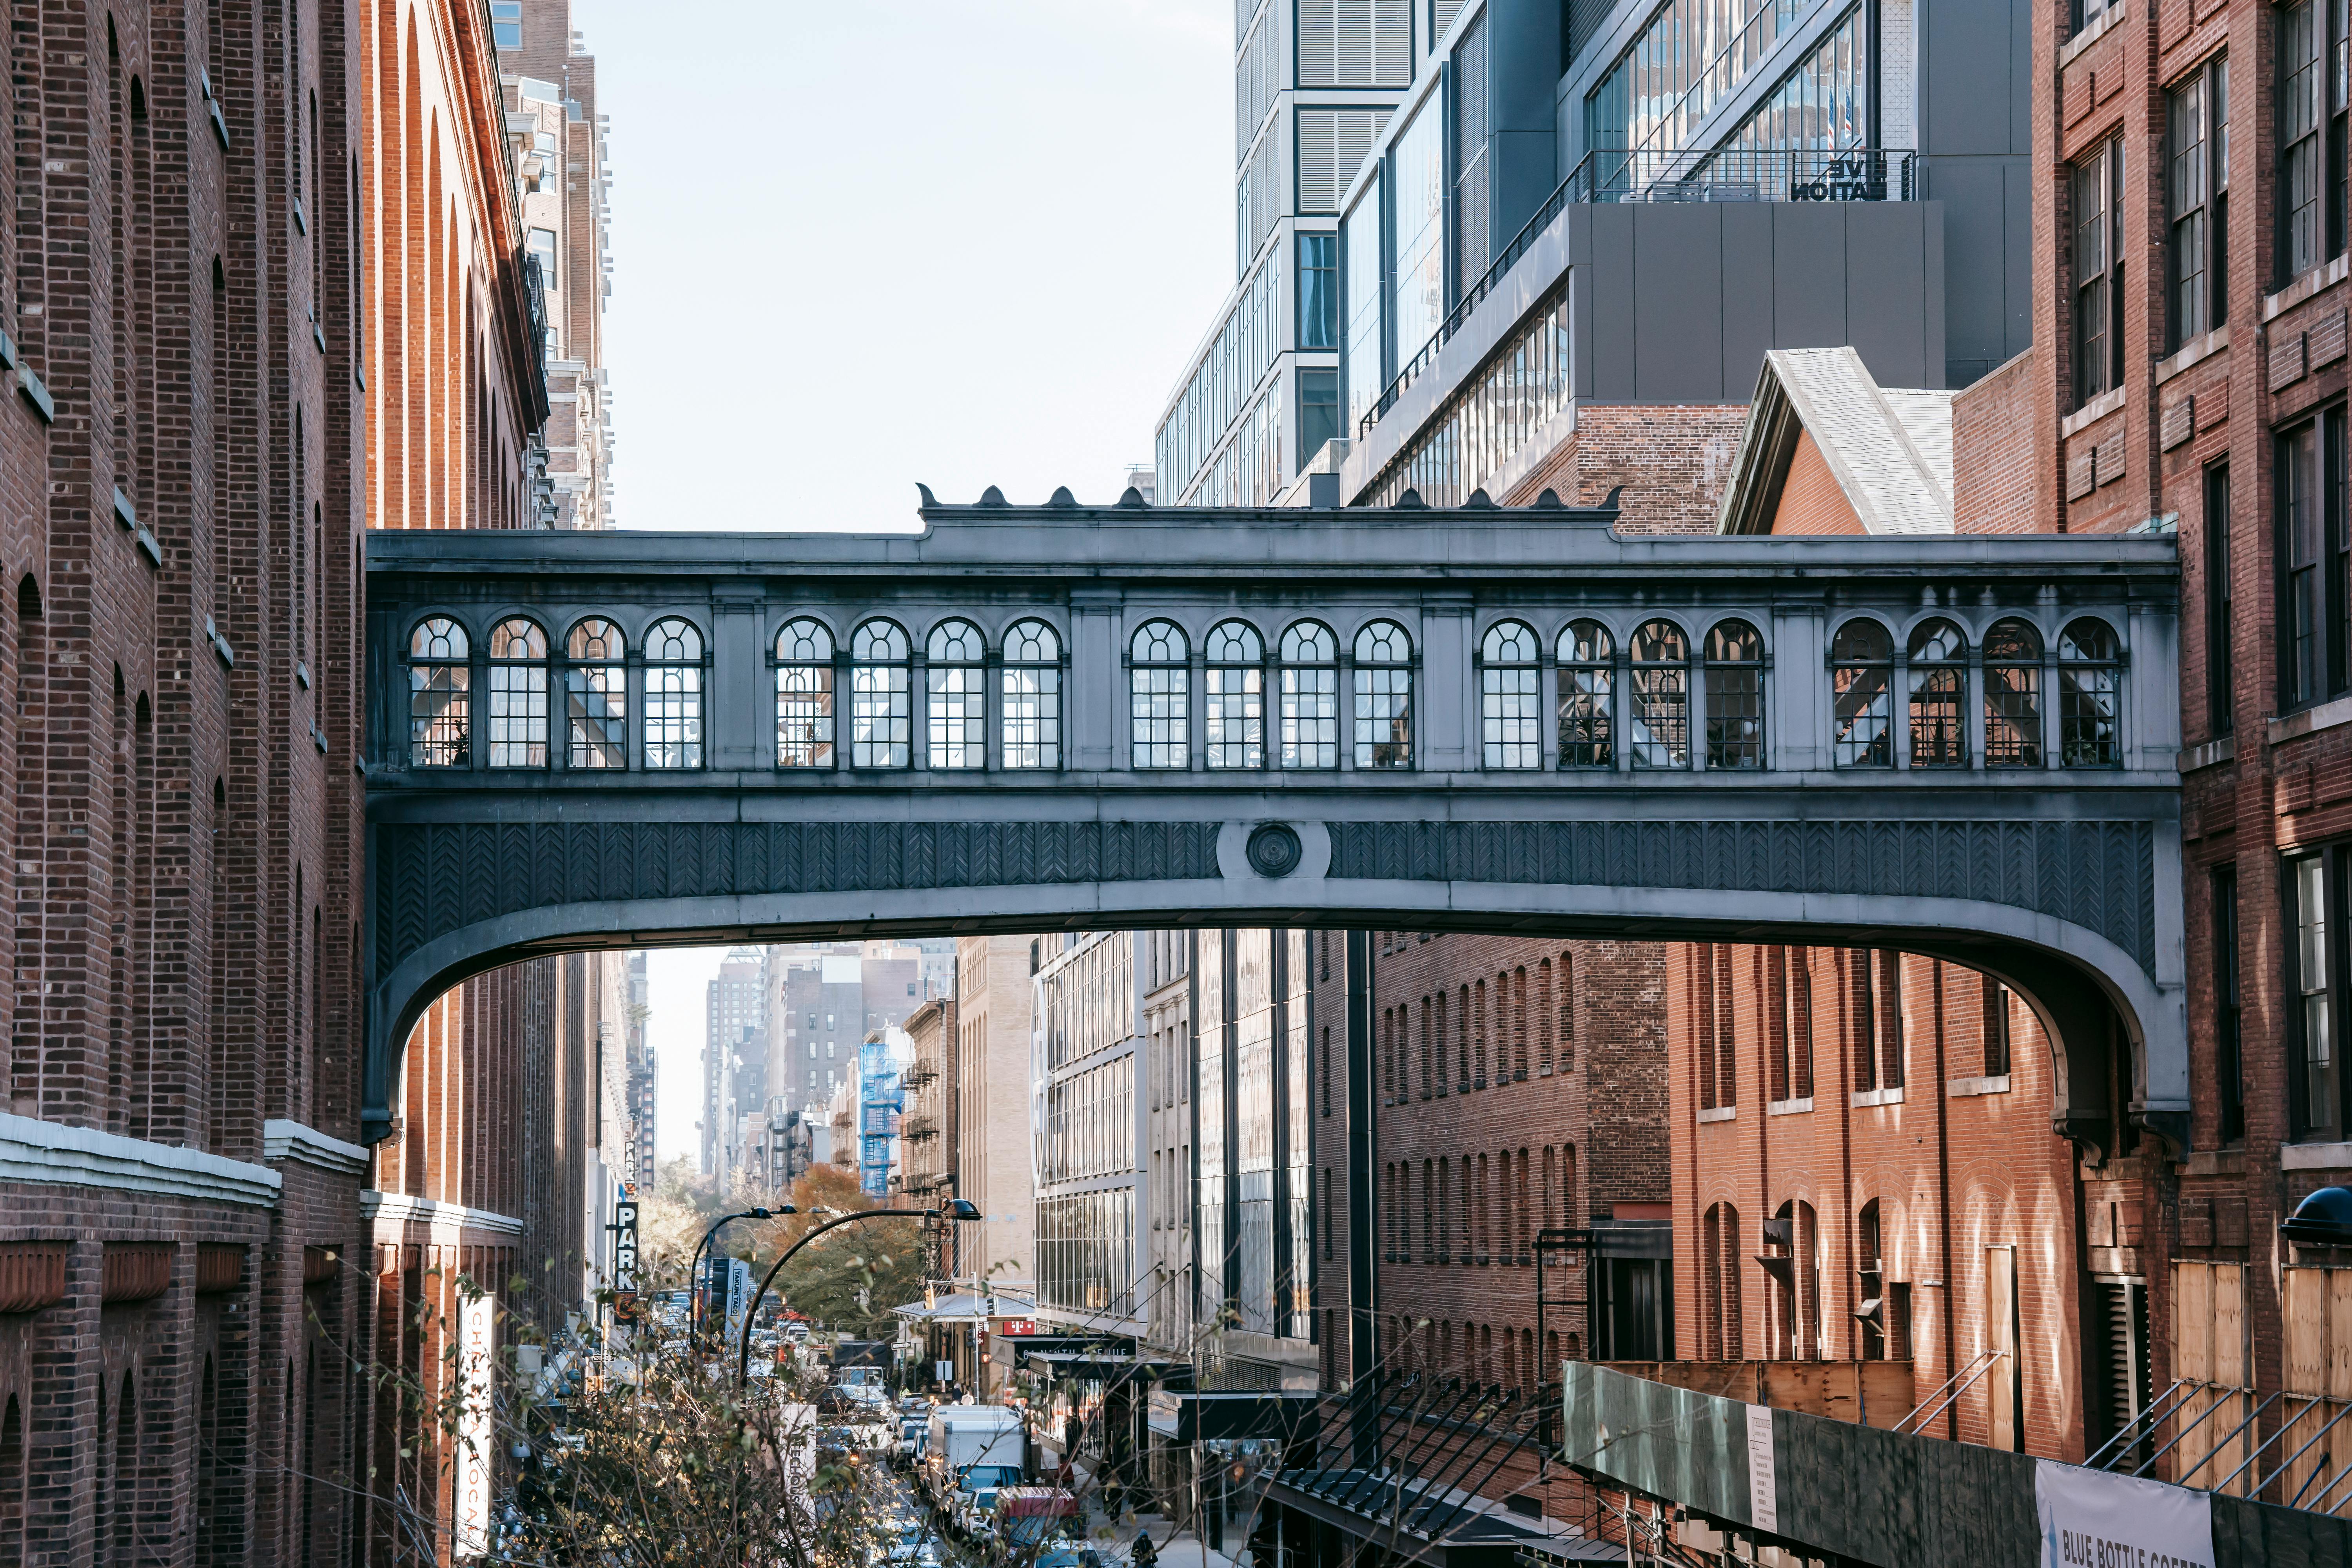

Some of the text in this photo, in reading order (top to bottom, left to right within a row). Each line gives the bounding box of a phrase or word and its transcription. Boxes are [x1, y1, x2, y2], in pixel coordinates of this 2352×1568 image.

[626, 1142, 634, 1181] PARK
[618, 1207, 636, 1290] PARK
[467, 1454, 479, 1538] LOCAL
[2063, 1529, 2093, 1568] BLUE
[2097, 1538, 2145, 1568] BOTTLE
